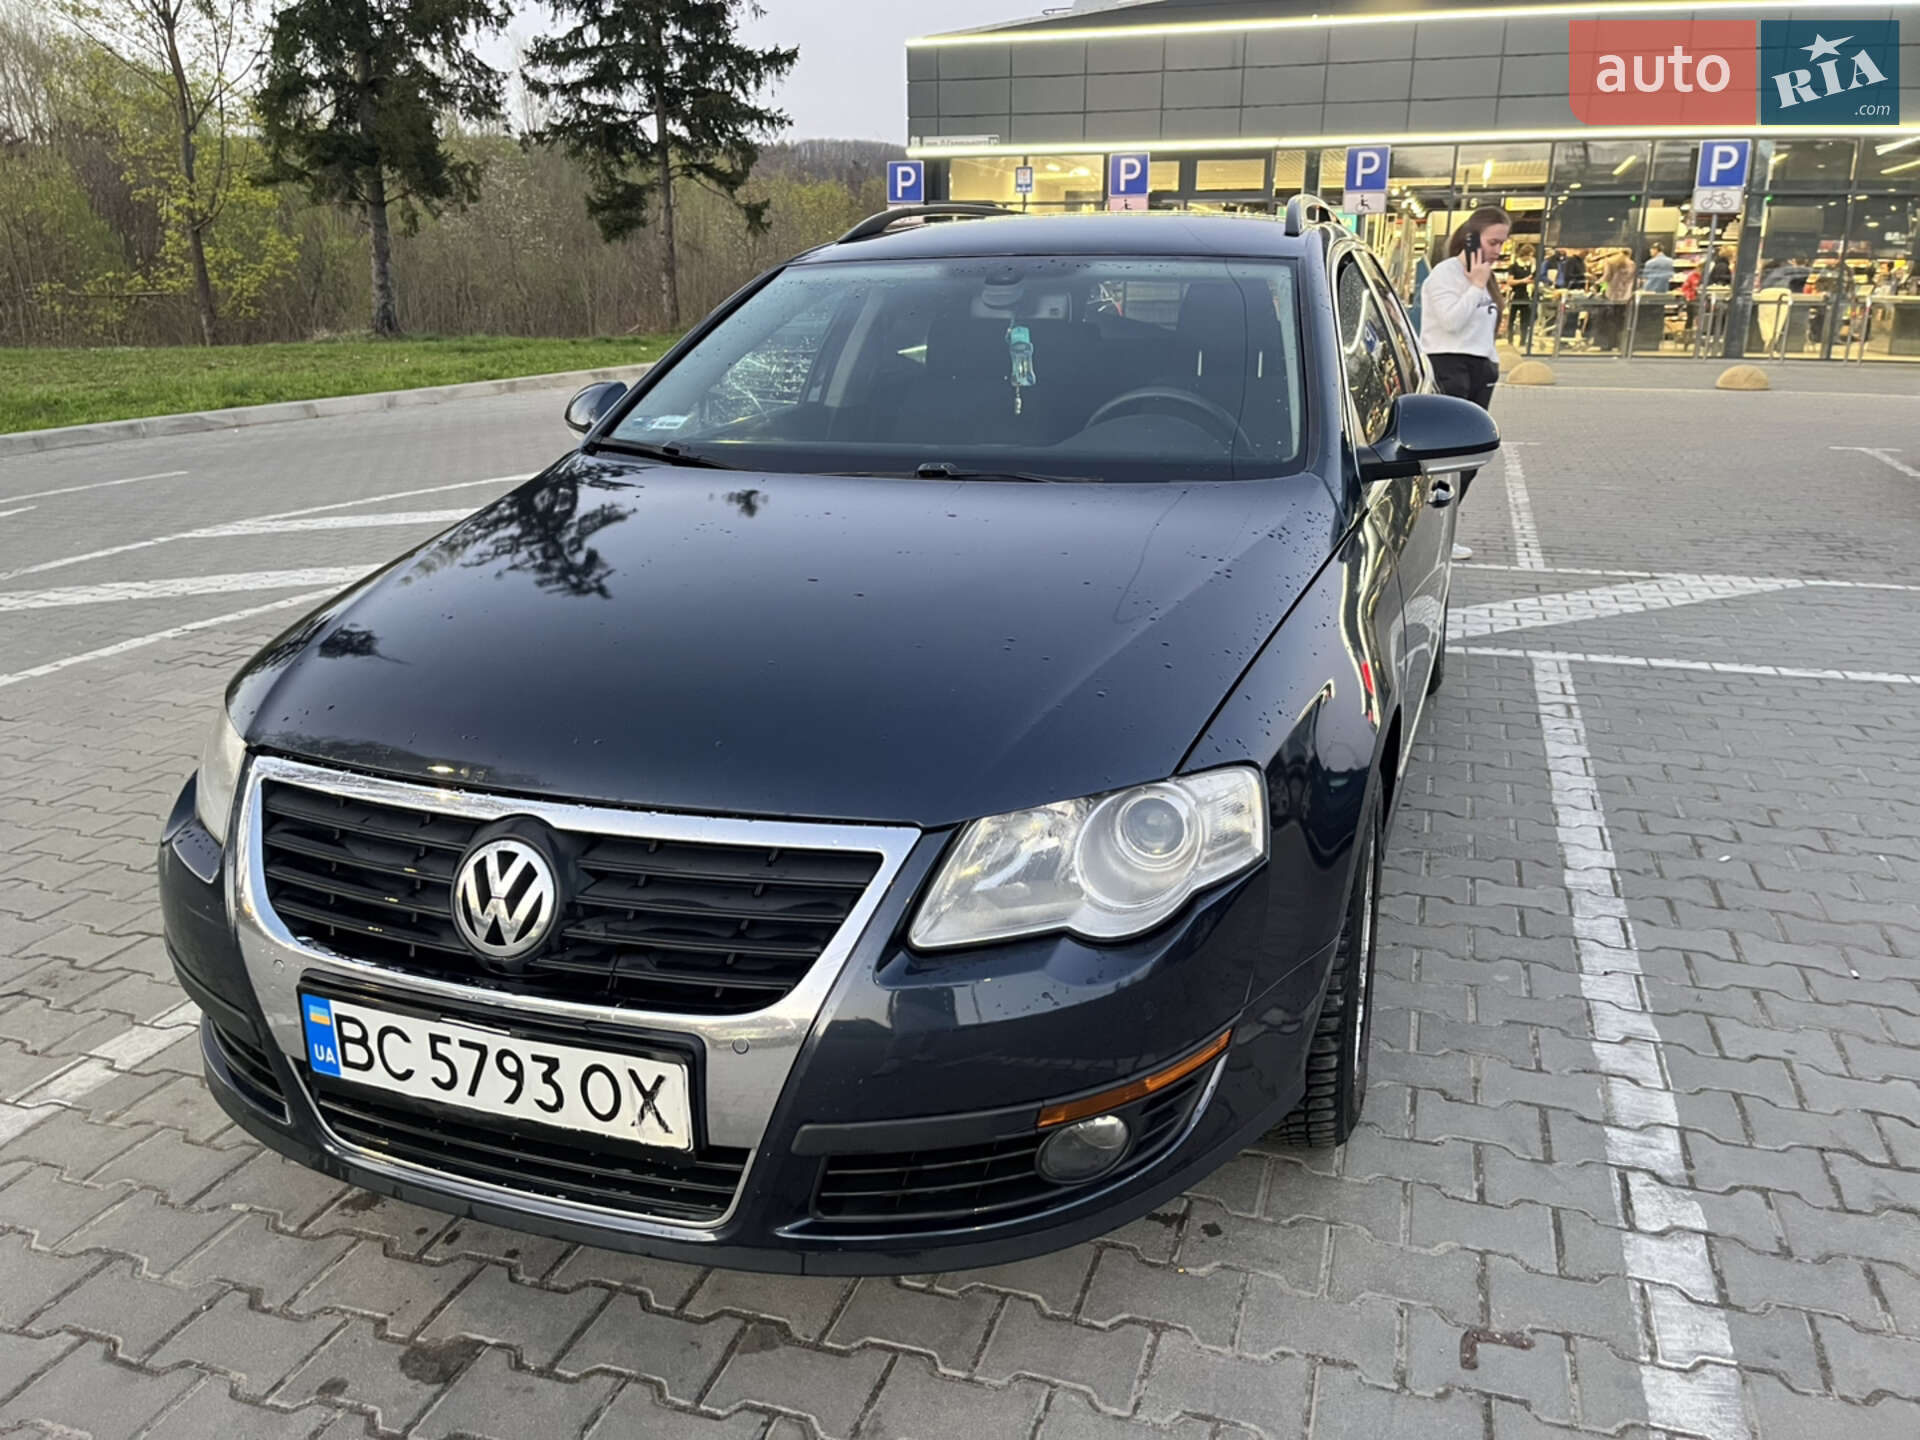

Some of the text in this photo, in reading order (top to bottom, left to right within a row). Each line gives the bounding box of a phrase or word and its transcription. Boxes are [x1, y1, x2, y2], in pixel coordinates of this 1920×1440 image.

[1120, 158, 1142, 191] P
[1355, 151, 1381, 187] P
[1710, 145, 1739, 182] P
[896, 166, 916, 198] P
[315, 1044, 336, 1065] UA
[334, 1013, 673, 1134] BC 5793 OX
